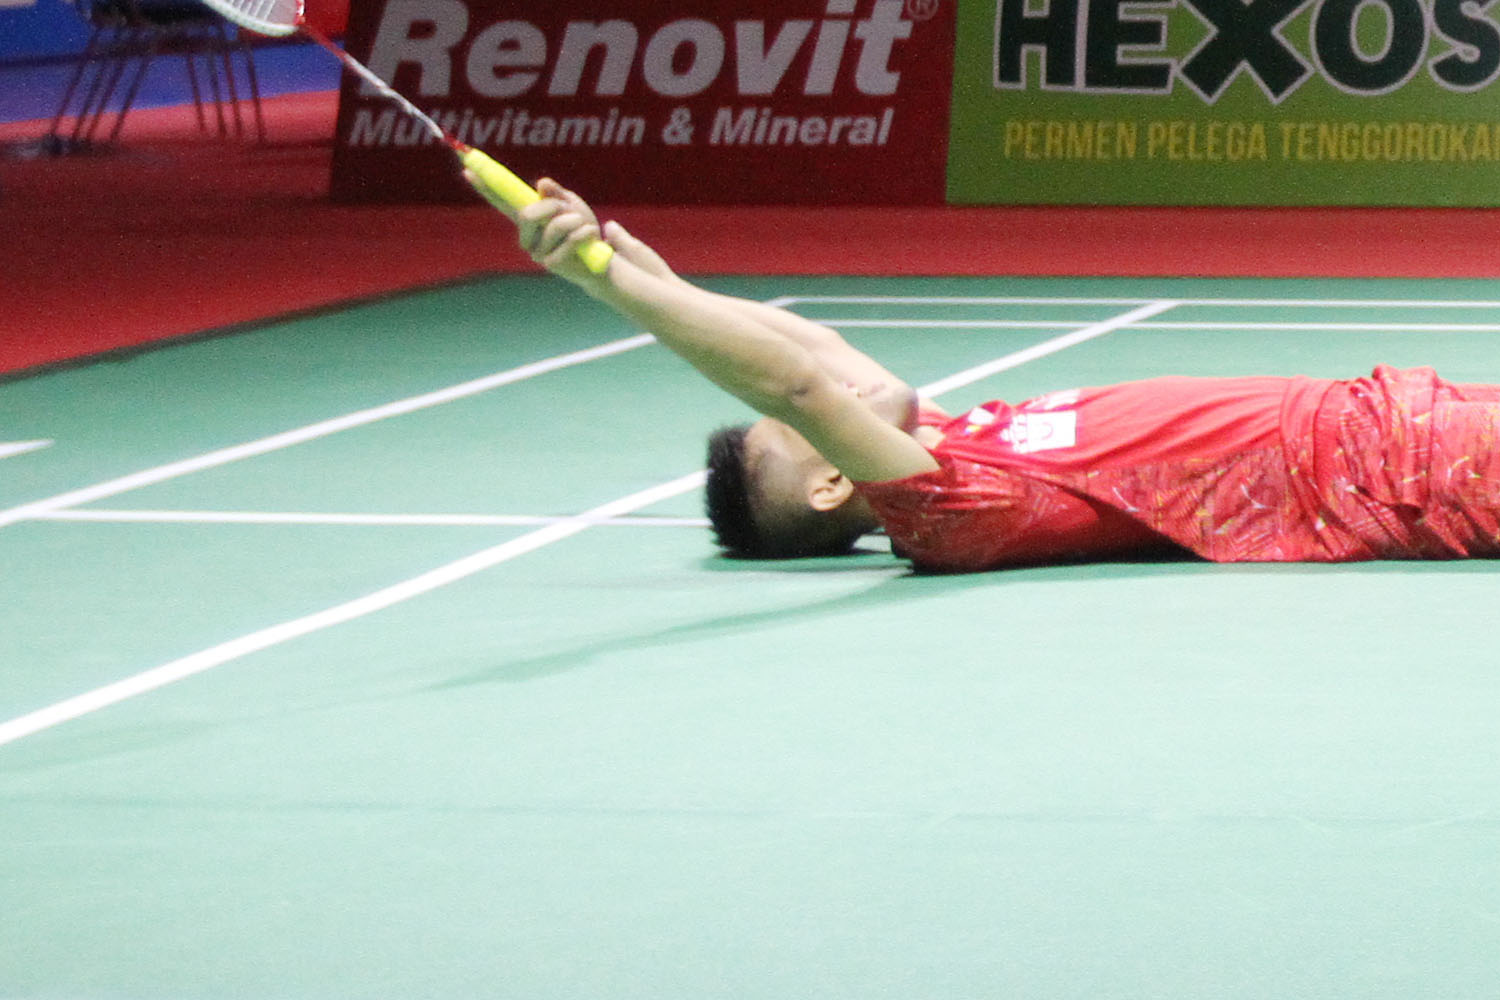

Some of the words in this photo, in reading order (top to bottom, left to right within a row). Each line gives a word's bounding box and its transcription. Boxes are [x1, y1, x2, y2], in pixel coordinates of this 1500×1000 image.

[350, 106, 646, 145] Multivitamin
[662, 108, 695, 145] &
[710, 107, 893, 145] Mineral
[1004, 120, 1138, 160] PERMEN
[1147, 121, 1267, 160] PELEGA
